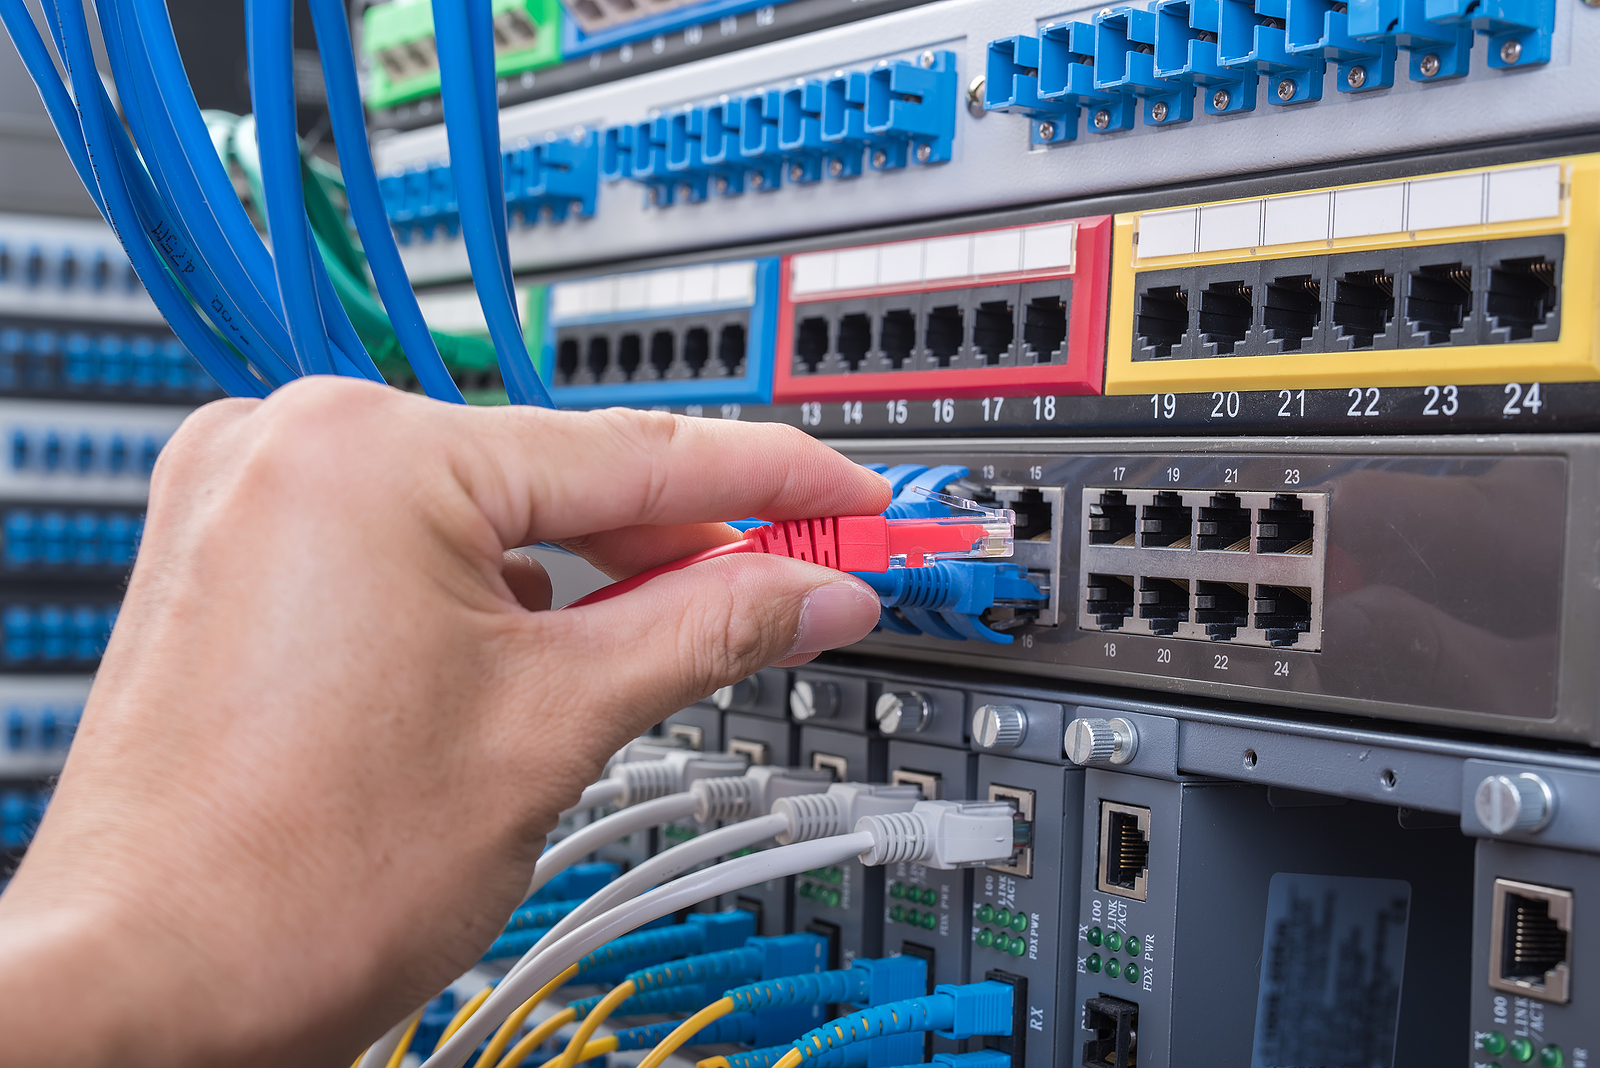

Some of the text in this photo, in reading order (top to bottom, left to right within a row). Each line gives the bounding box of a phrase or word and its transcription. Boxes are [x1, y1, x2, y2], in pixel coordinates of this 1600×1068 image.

[756, 4, 776, 27] 12
[801, 395, 1056, 426] 13 14 15 16 17 18
[1150, 382, 1542, 419] 19 20 21 22 23 24
[982, 465, 1042, 480] 13 15
[1113, 467, 1300, 485] 17 19 21 23
[1021, 634, 1033, 649] 16
[1103, 643, 1290, 677] 18 20 22 24
[985, 875, 994, 897] 100
[997, 875, 1007, 906] LINK
[1092, 899, 1102, 923] 100
[1107, 899, 1118, 931] LINK
[1116, 901, 1127, 934] /ACT
[1029, 912, 1040, 961] FDX PWR
[1078, 923, 1089, 942] TX
[1077, 955, 1087, 974] FX
[1142, 933, 1155, 992] FDX PWR
[1029, 1005, 1044, 1032] RX
[1493, 996, 1508, 1025] 100
[1514, 996, 1529, 1037] LINK
